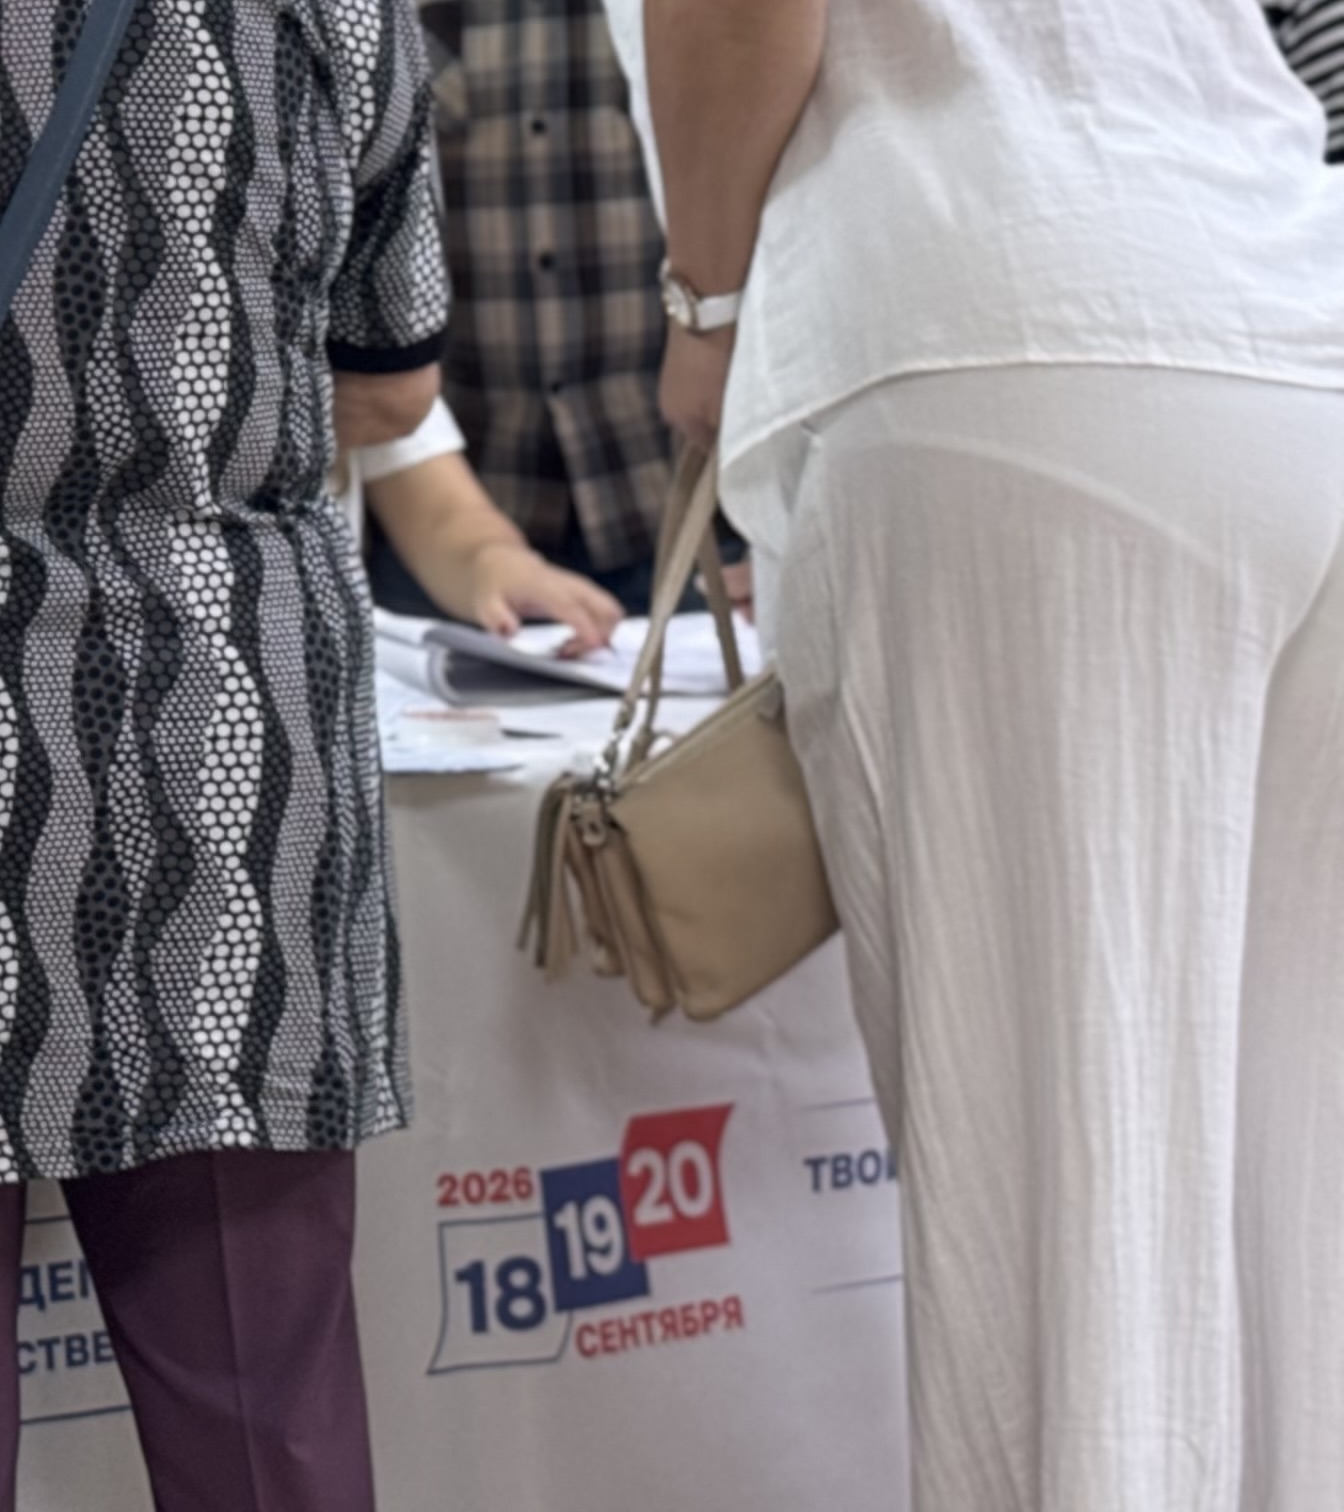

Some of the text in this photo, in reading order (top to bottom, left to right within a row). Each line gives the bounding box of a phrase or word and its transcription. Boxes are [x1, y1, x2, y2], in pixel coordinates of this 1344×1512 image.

[436, 1167, 534, 1208] 2026
[626, 1139, 715, 1227] 20
[553, 1194, 626, 1281] 19
[454, 1255, 549, 1335] 18
[574, 1294, 745, 1358] СЕНТЯБРЯ
